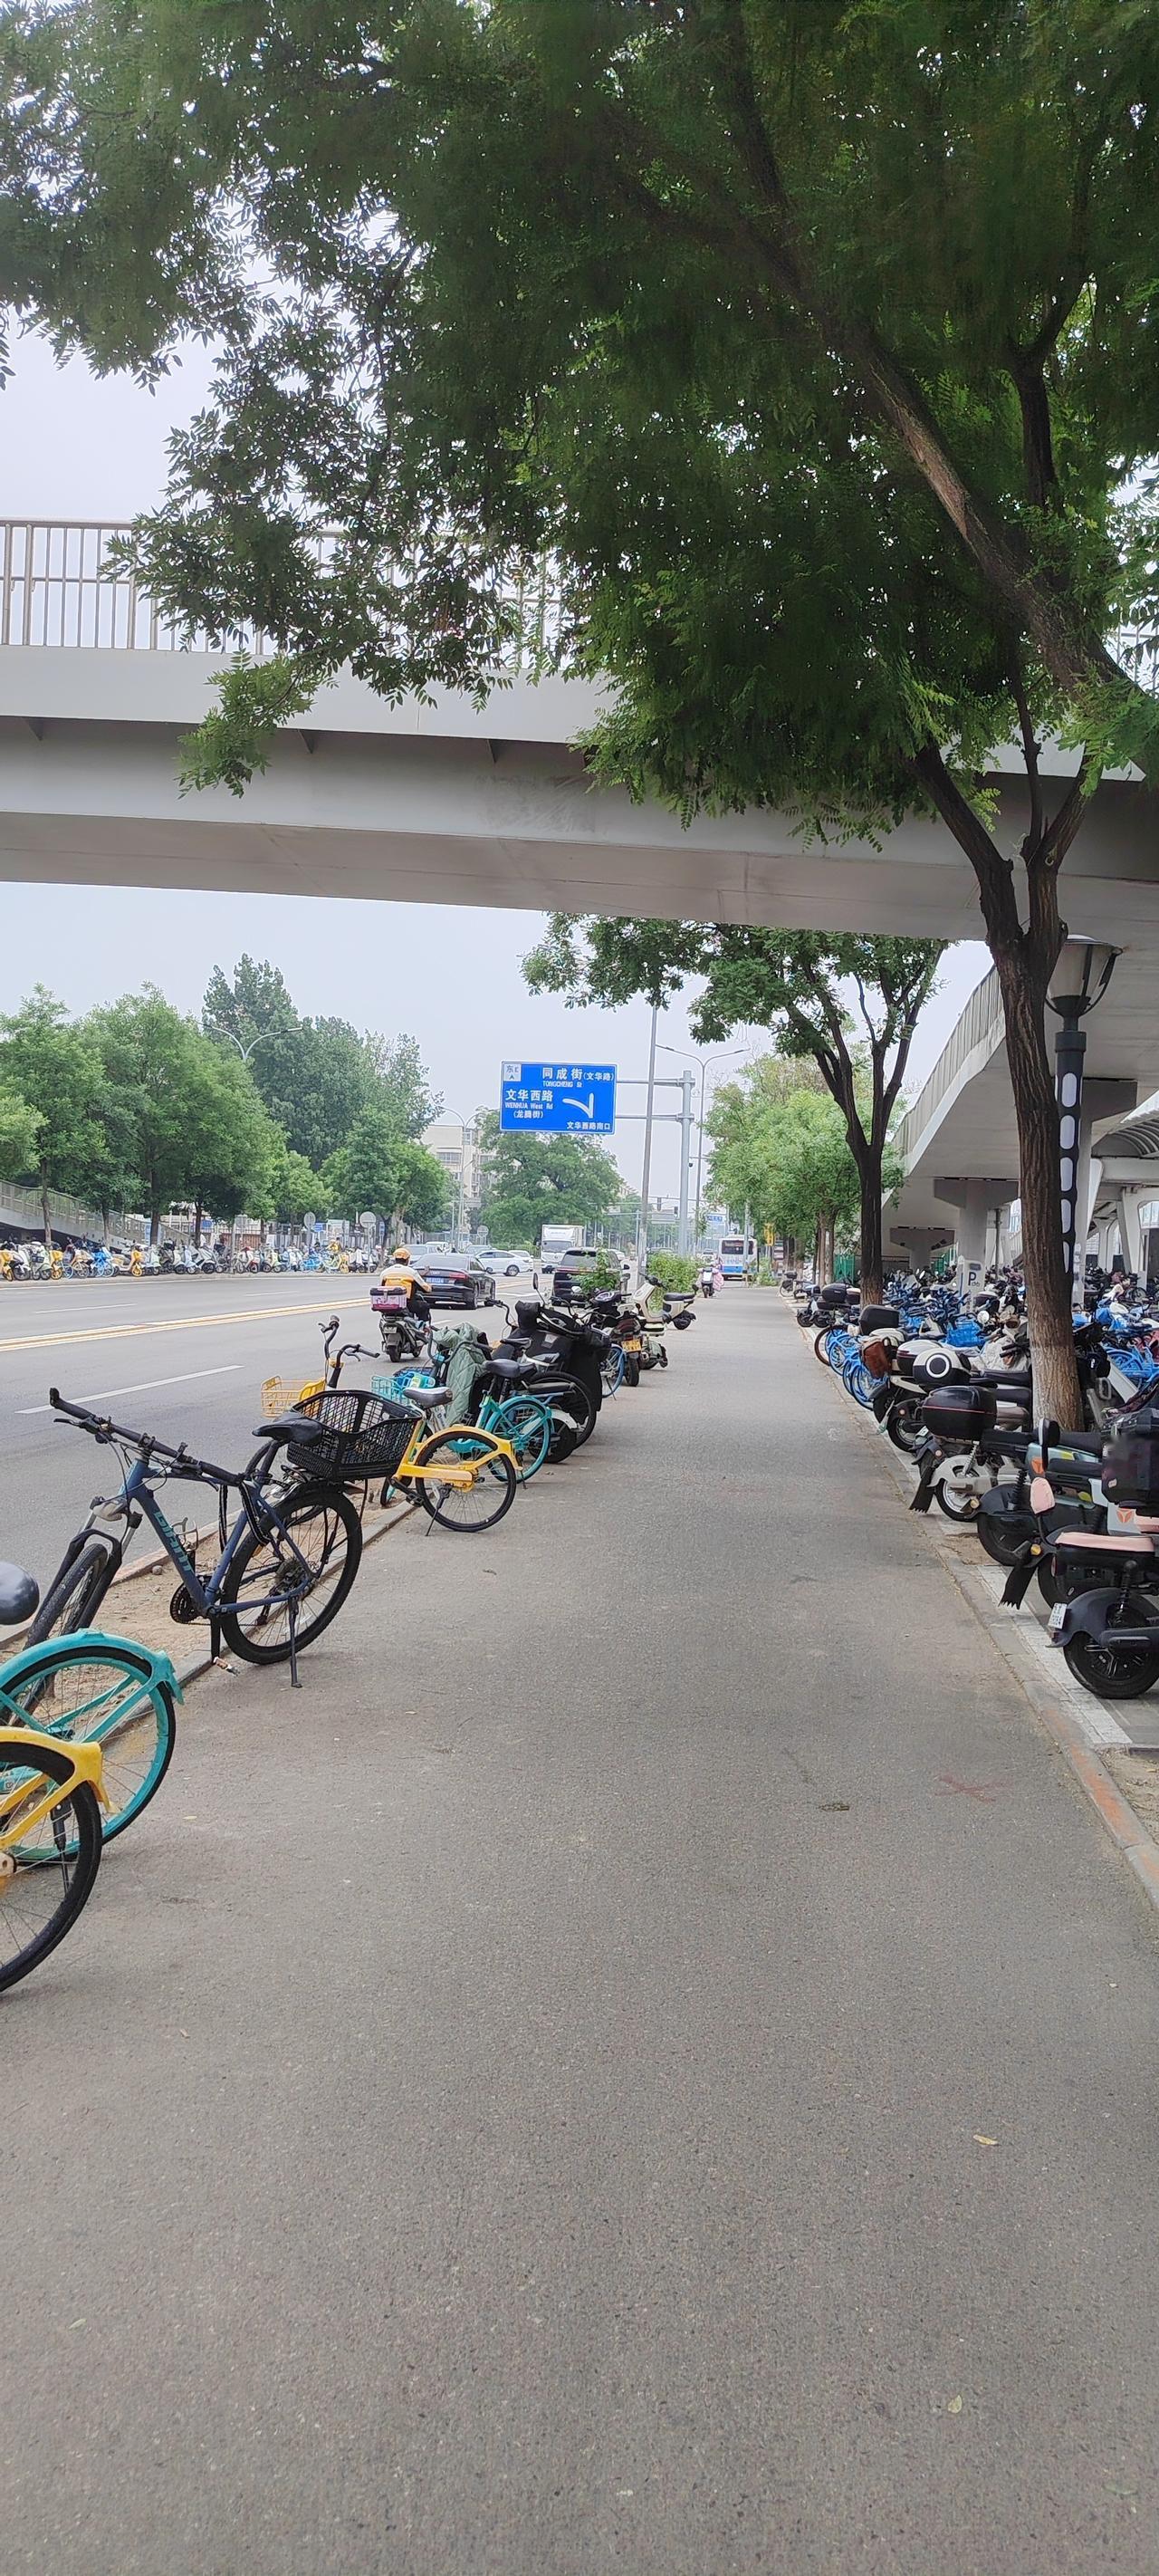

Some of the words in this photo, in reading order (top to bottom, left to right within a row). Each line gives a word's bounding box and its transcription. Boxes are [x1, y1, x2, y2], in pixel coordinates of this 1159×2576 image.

[542, 1067, 583, 1080] 同成街
[505, 1089, 553, 1101] 文华西路
[505, 1101, 528, 1110] WENHUA
[968, 1272, 976, 1286] P
[153, 1511, 192, 1572] GIANT
